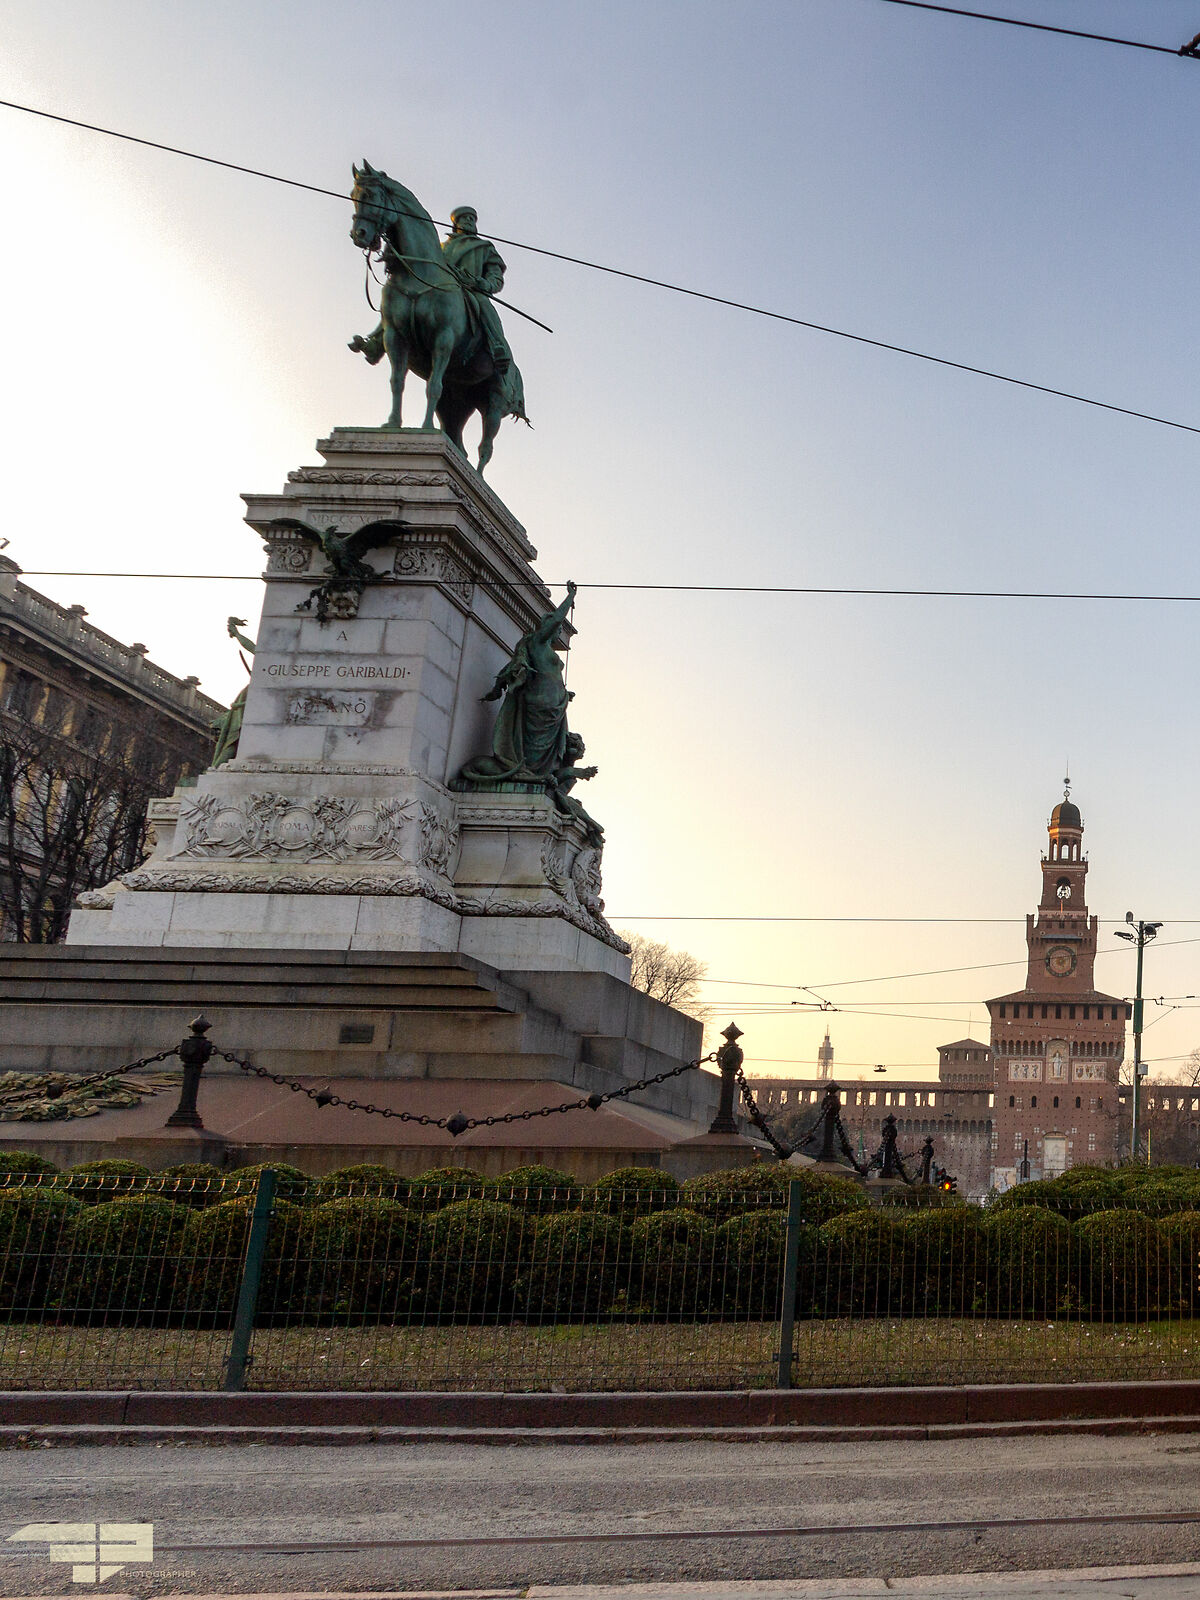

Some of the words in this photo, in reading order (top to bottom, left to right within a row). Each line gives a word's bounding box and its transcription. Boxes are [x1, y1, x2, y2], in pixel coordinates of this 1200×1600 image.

[336, 631, 348, 641] A
[279, 822, 310, 832] ROMA
[347, 823, 377, 832] VARESE
